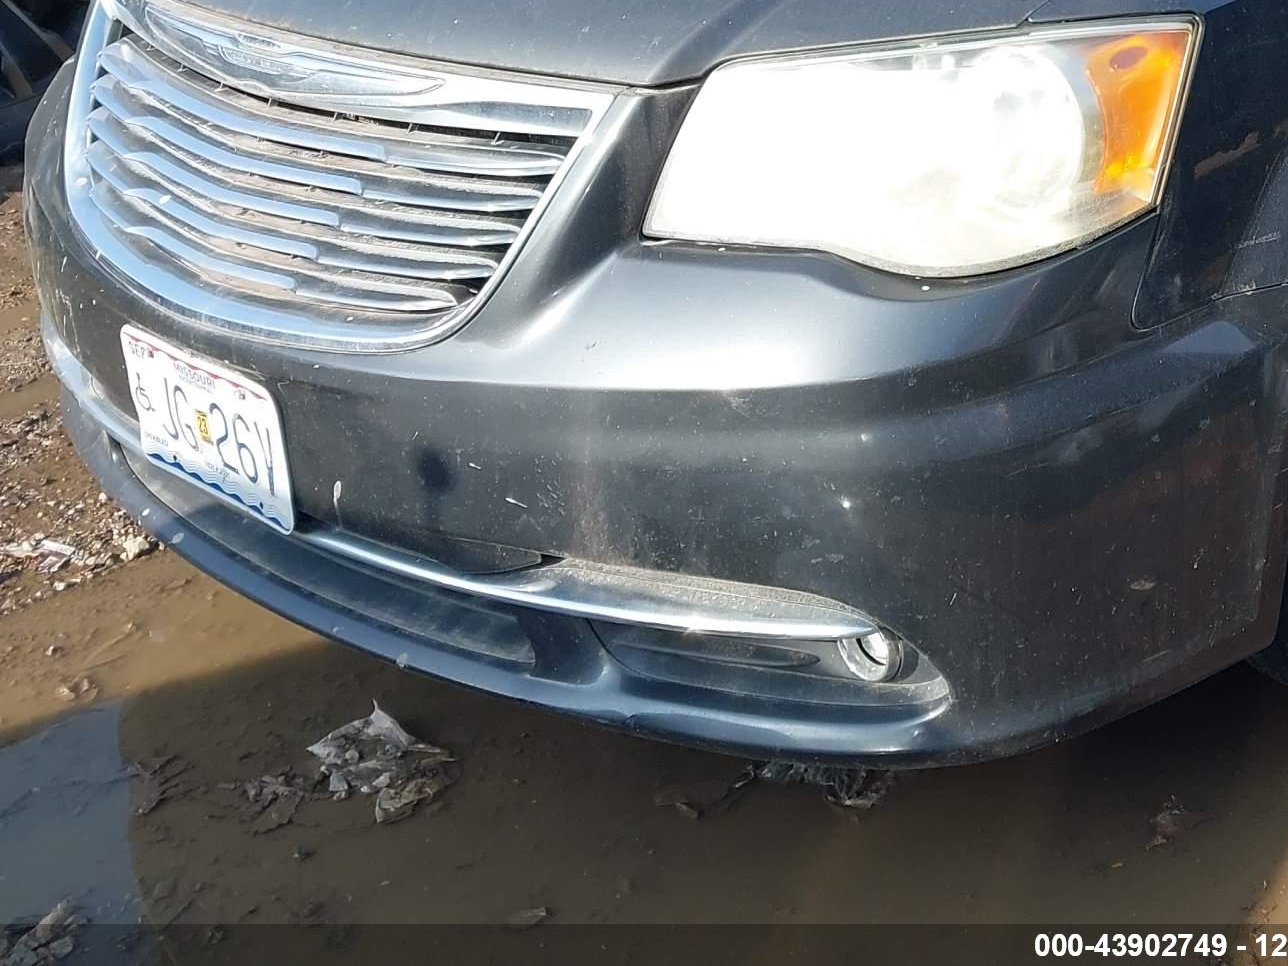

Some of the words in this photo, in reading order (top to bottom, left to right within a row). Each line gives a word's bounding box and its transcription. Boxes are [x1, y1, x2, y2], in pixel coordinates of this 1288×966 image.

[173, 361, 216, 389] MISSOURI
[162, 377, 200, 453] JG
[197, 414, 209, 436] 23
